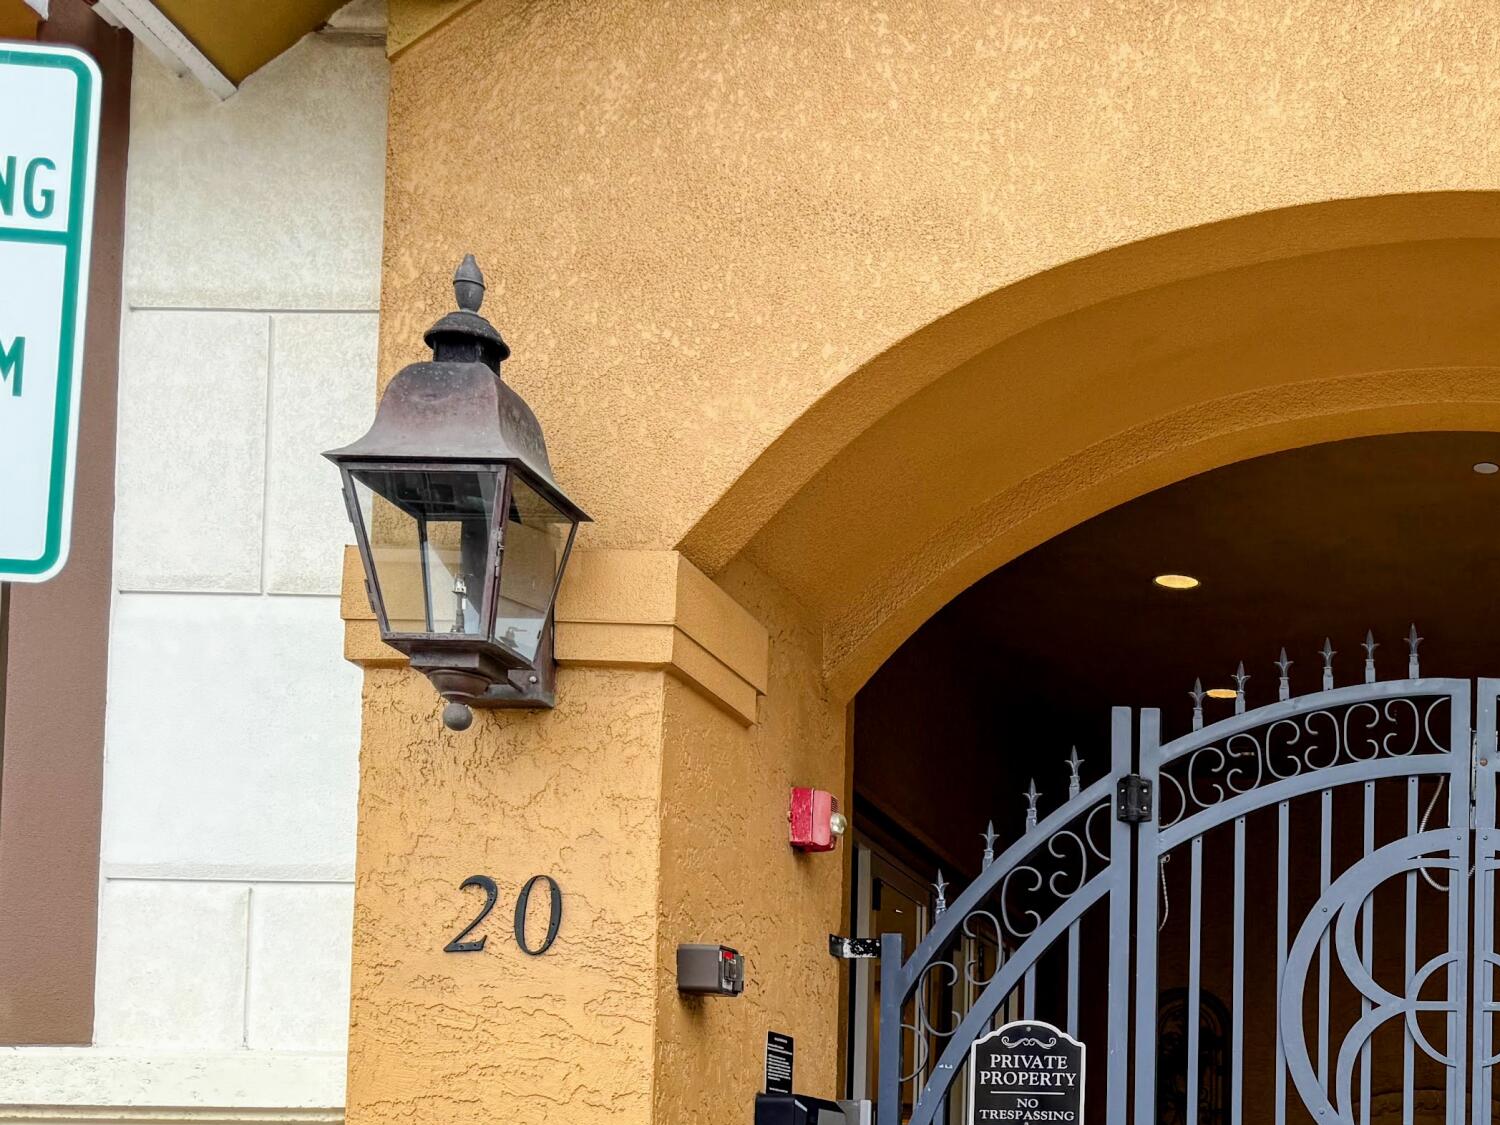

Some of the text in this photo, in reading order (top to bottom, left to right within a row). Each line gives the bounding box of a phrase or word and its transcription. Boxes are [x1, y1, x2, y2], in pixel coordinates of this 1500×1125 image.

[0, 155, 56, 218] NG
[443, 874, 562, 956] 20
[990, 1054, 1068, 1069] PRIVATE
[980, 1071, 1077, 1087] PROPERTY
[1017, 1098, 1039, 1109] NO
[979, 1109, 1075, 1121] TRESPASSING
